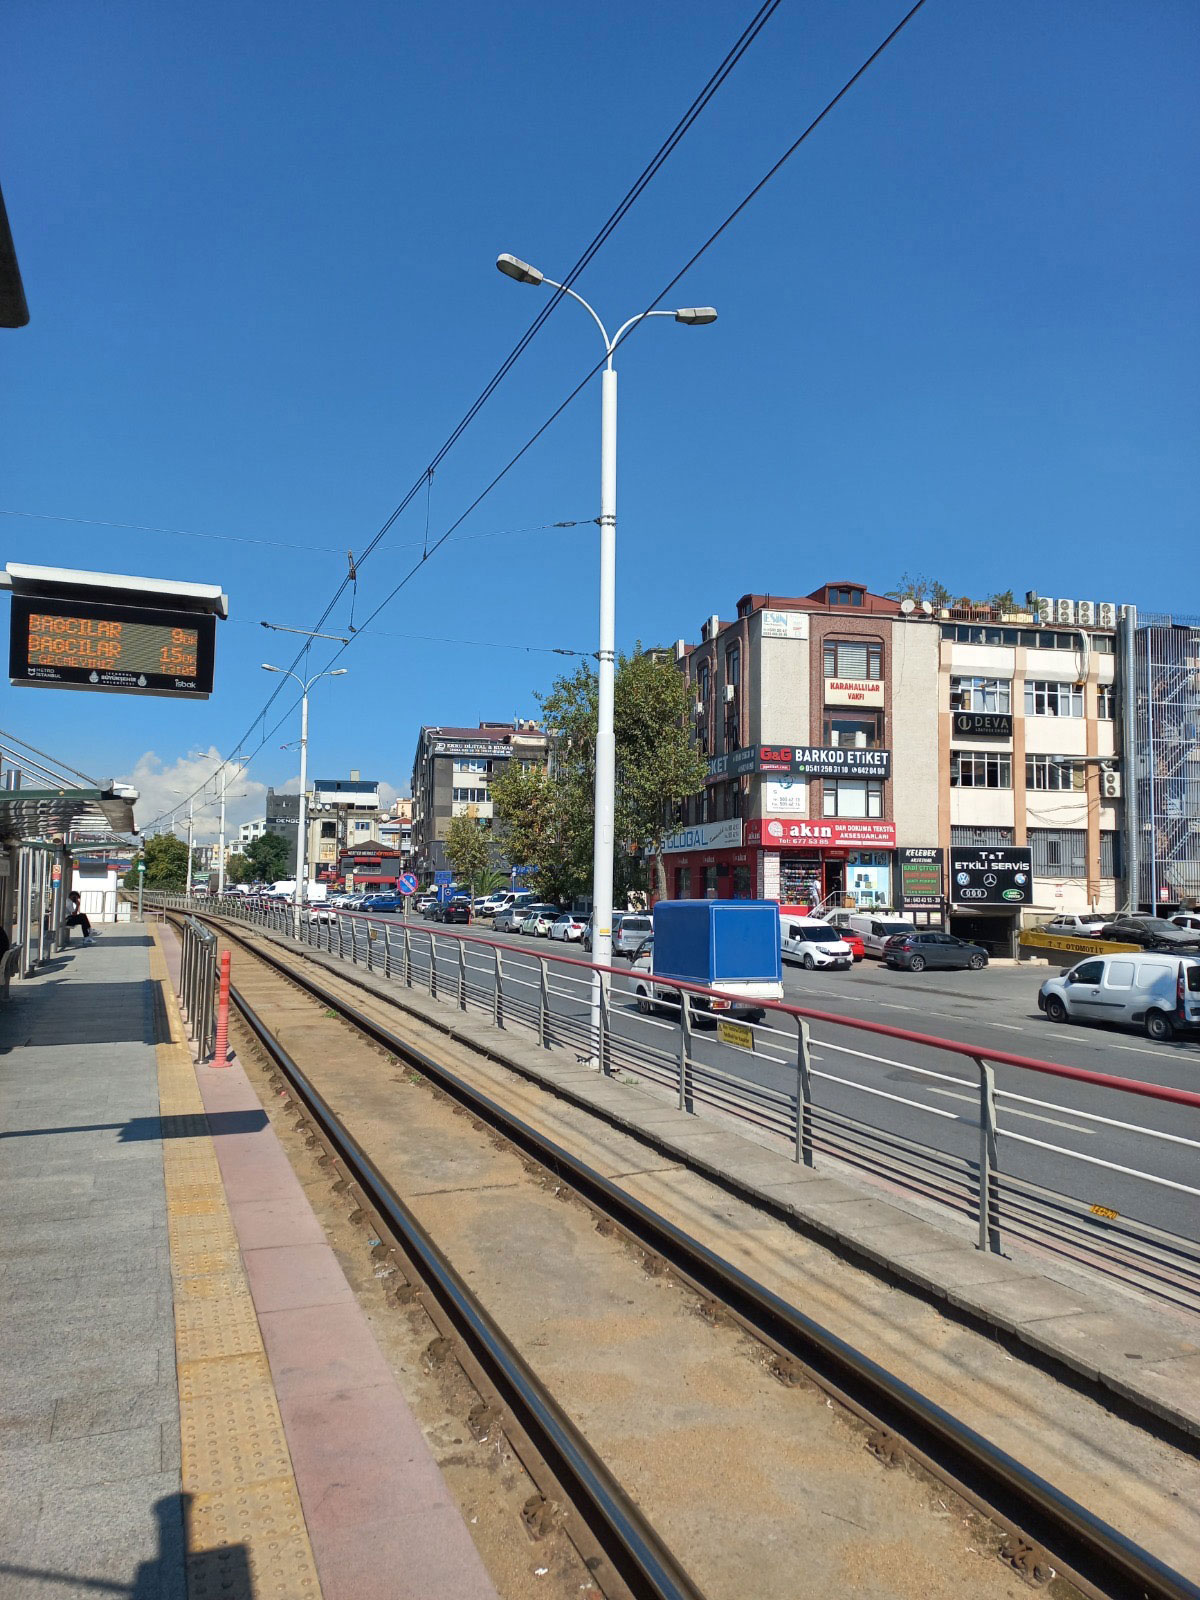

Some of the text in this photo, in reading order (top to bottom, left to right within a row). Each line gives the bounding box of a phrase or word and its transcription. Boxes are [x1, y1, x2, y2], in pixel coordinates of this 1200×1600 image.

[29, 614, 122, 637] BAGCILAR
[28, 634, 122, 658] BAGCILAR
[830, 682, 880, 692] KARAHALLILAR
[848, 692, 865, 700] VAKFI
[974, 716, 1009, 728] DEVA
[760, 747, 793, 762] G&G
[795, 749, 844, 763] BARKOD
[789, 823, 832, 838] akın
[667, 828, 709, 849] GLOBAL
[905, 849, 937, 857] KELEBEK
[979, 851, 988, 860] T
[995, 851, 1005, 860] T
[954, 861, 1030, 871] ETKİLİ SERVİS
[1065, 944, 1104, 954] OTOMOTİV
